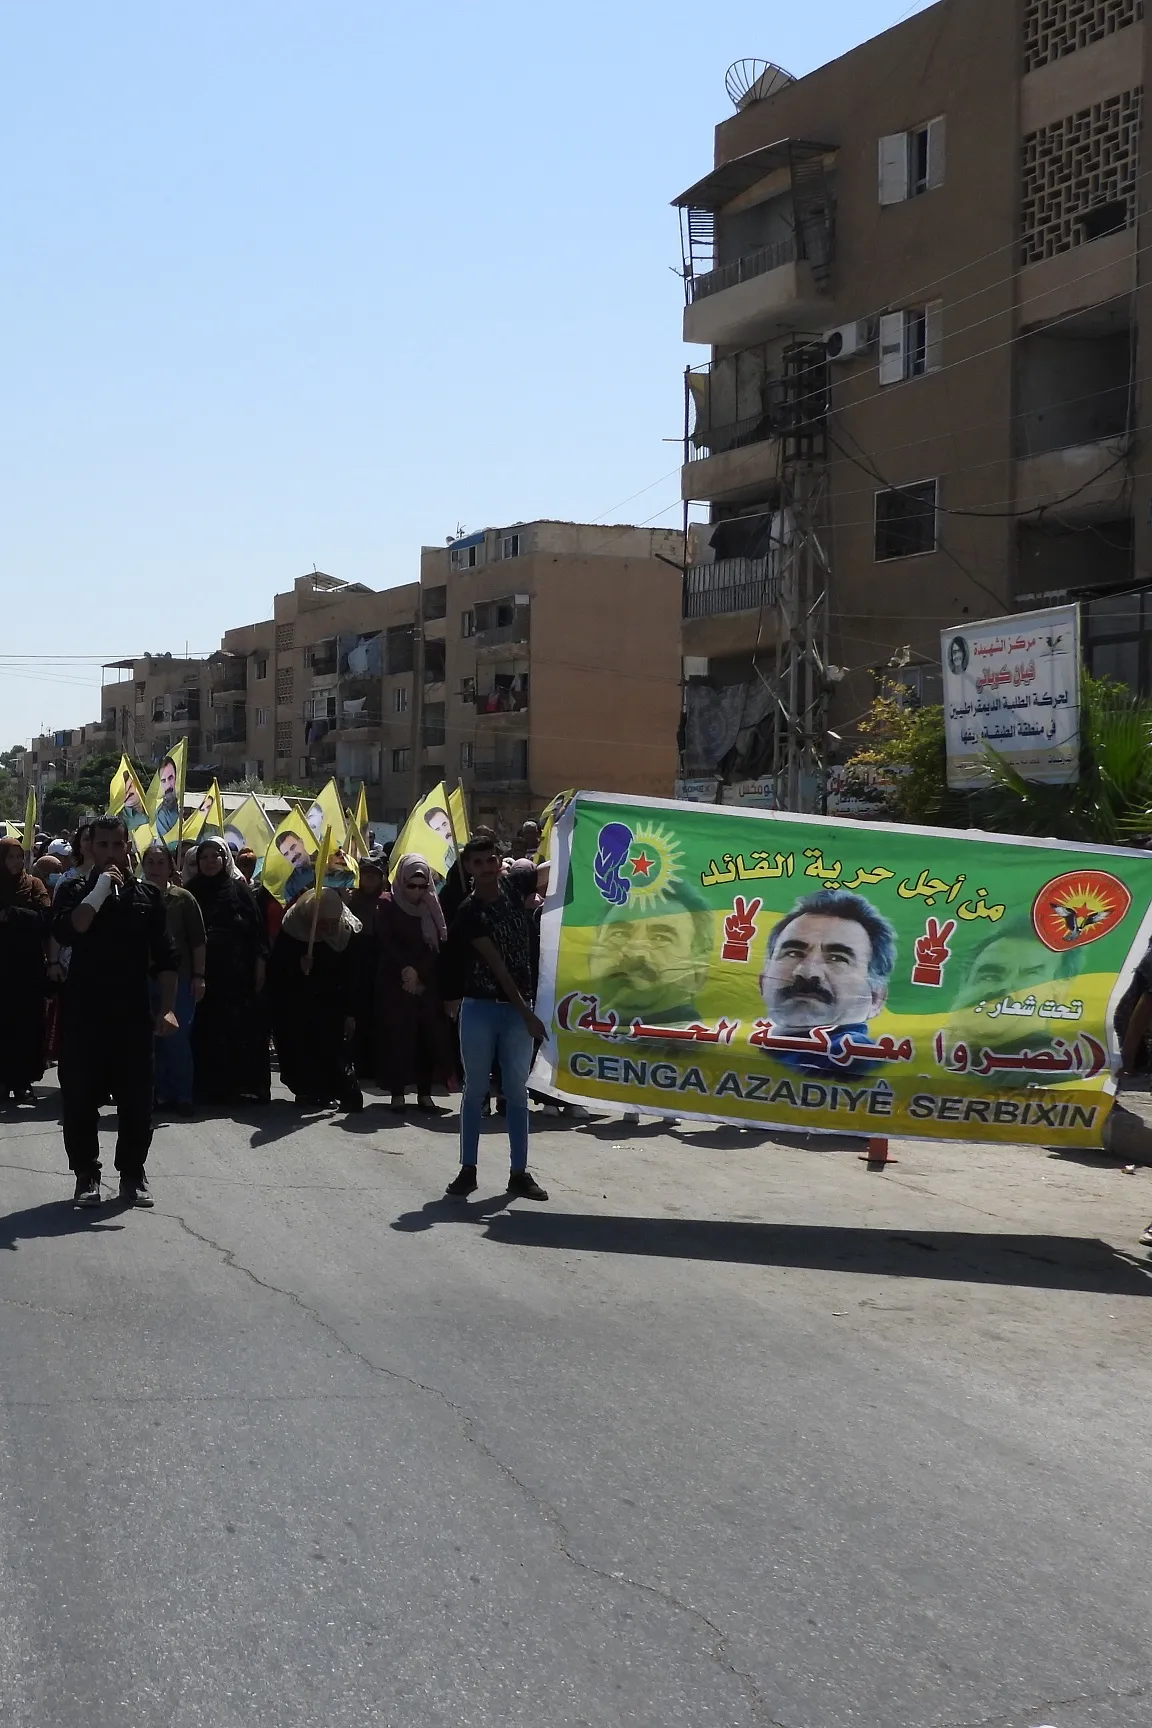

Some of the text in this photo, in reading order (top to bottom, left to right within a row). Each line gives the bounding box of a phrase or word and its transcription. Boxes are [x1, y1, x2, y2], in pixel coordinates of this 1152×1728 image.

[701, 848, 1006, 922] من أجل حرية القائد
[1038, 1000, 1084, 1020] تحت
[749, 1018, 915, 1066] معركة
[569, 1052, 1098, 1128] CENGA AZADIYÊ SERBIXIN
